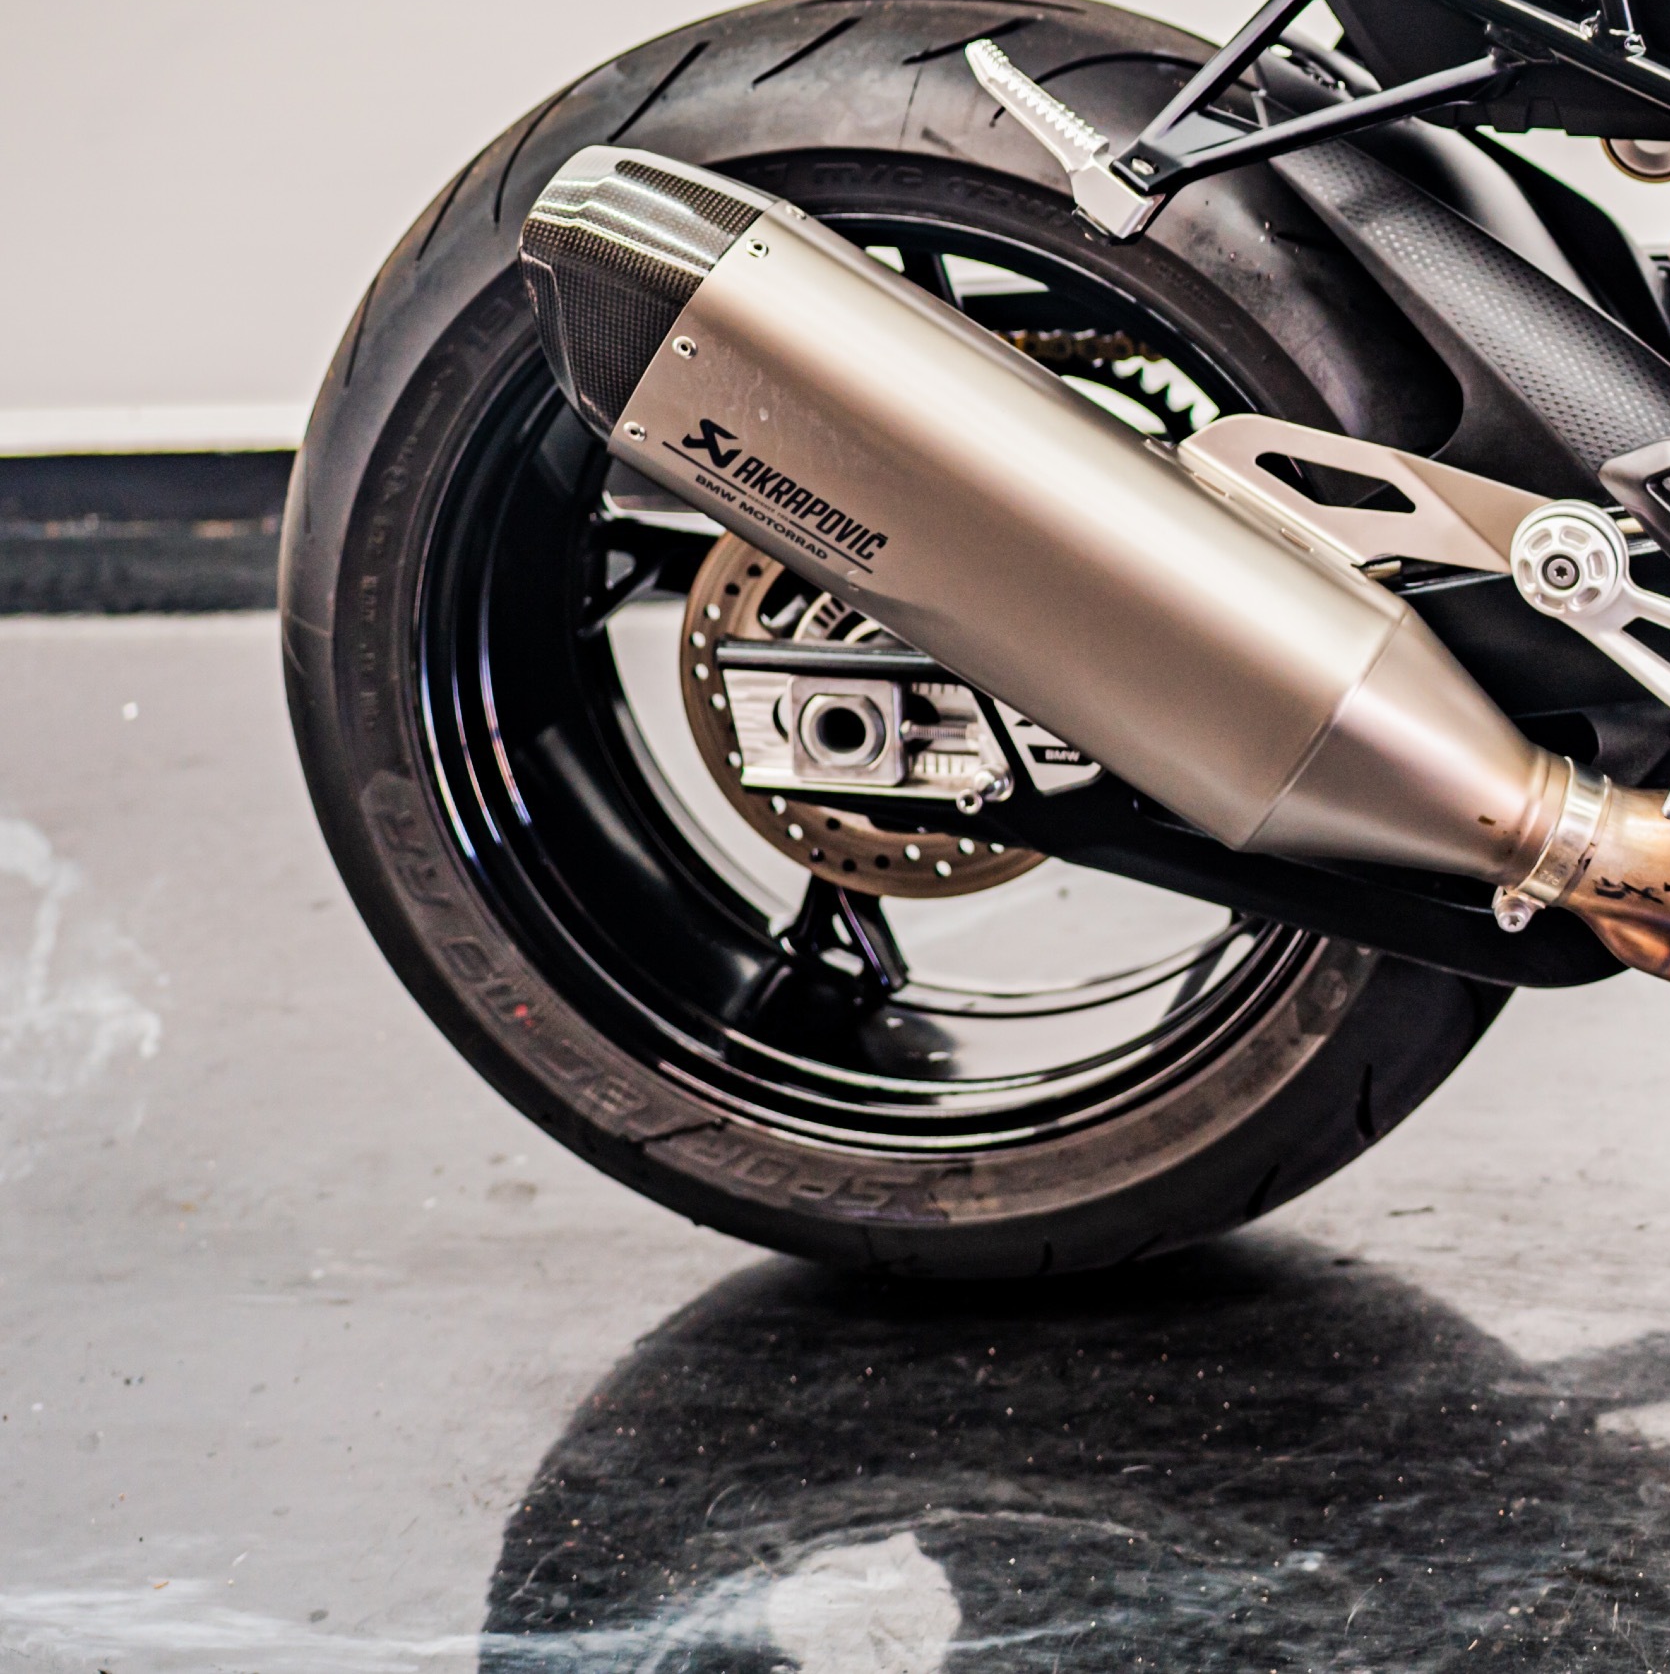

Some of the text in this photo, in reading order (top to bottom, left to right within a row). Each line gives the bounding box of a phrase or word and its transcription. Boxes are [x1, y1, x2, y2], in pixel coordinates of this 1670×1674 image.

[695, 474, 828, 560] BMW MOTORRAD
[732, 456, 888, 560] AKRAPOVIČ
[1045, 749, 1080, 762] BMW
